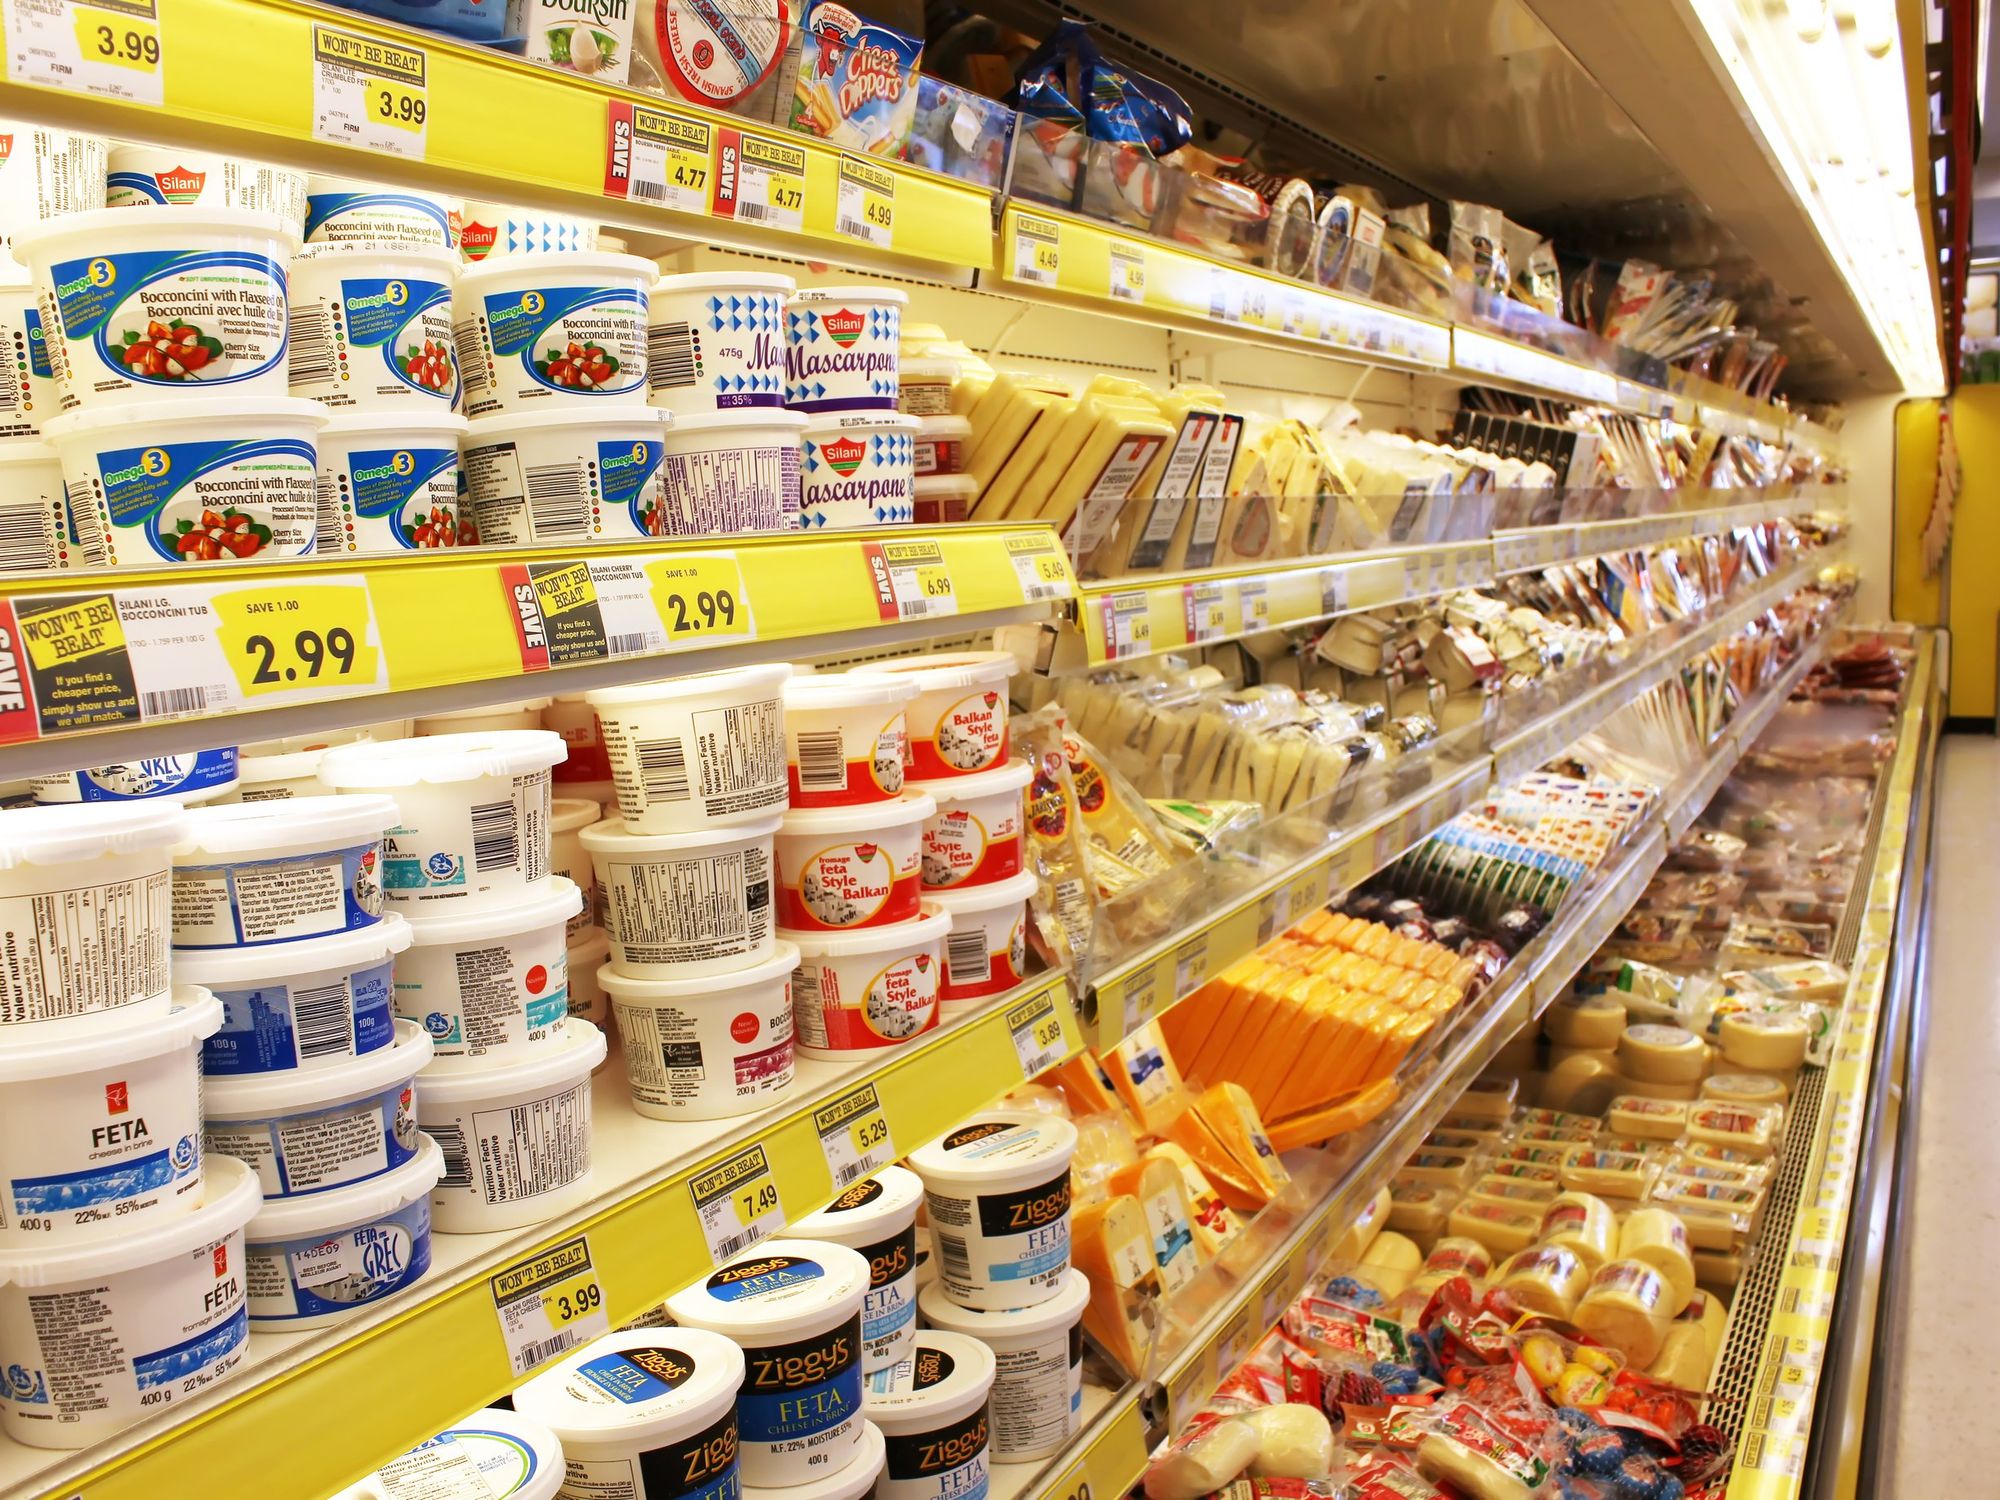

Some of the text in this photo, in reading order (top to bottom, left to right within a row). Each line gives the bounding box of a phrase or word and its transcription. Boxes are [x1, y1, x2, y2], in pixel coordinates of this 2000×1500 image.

[97, 25, 160, 65] 3.99
[322, 33, 362, 58] WON'T
[364, 45, 382, 63] BE
[383, 50, 418, 73] BEAT
[669, 10, 734, 96] SPANISH FRESH CHEESE
[50, 63, 73, 75] FIRM
[321, 62, 342, 75] SILANI
[342, 66, 356, 77] LITE
[321, 70, 372, 88] CRUMBLED FETA
[379, 91, 426, 125] 3.99
[343, 123, 360, 133] FIRM
[639, 114, 705, 142] WON'T BE BEAT
[612, 120, 630, 180] SAVE
[161, 176, 201, 191] Silani
[674, 166, 706, 189] 4.77
[719, 146, 737, 200] SAVE
[775, 188, 802, 209] 4.77
[867, 202, 892, 226] 4.99
[461, 231, 492, 244] Silani
[1040, 249, 1058, 268] 4.49
[57, 261, 110, 299] Omega 3
[140, 289, 209, 304] Bocconcini
[212, 289, 237, 303] with
[239, 290, 275, 307] Flaxseed
[489, 294, 540, 323] Omega 3
[147, 304, 276, 320] Bocconcini avec huile de
[828, 317, 861, 331] Silani
[224, 343, 260, 355] Cherry Size
[225, 352, 266, 362] Format cerise
[719, 347, 743, 359] 475g
[785, 345, 896, 381] Mascarpone
[602, 445, 645, 469] Omega 3
[826, 446, 861, 460] Silani
[104, 451, 164, 487] Omega 3
[590, 564, 633, 574] SILANI CHERRY
[592, 571, 644, 582] BOCCONCINI TUB
[666, 568, 698, 578] SAVE 1.00
[871, 555, 893, 605] SAVE
[1042, 561, 1065, 579] 5.49
[536, 567, 589, 596] WON'T BE
[927, 578, 951, 596] 6.99
[119, 597, 172, 611] SILANI LG.
[246, 600, 300, 614] SAVE 1.00
[552, 586, 582, 610] BEAT
[121, 605, 208, 622] BOCCONCINI TUB
[512, 583, 545, 649] SAVE
[668, 589, 735, 632] 2.99
[22, 603, 114, 643] WON'T BE
[50, 626, 103, 659] BEAT
[244, 627, 356, 685] 2.99
[55, 676, 64, 686] If
[65, 676, 81, 688] you
[84, 672, 103, 683] find
[52, 684, 122, 700] cheaper price,
[42, 697, 136, 717] simply show us and
[953, 710, 993, 726] Balkan
[56, 711, 126, 727] we will match.
[967, 722, 993, 736] Style
[982, 732, 999, 744] feta
[699, 735, 713, 795] Nutrition Facts
[709, 732, 722, 795] Valeur nutritive
[818, 856, 851, 864] fromage
[820, 864, 847, 874] feta
[822, 875, 857, 887] Style
[842, 885, 889, 900] Balkan
[5, 931, 26, 1022] Valeur nutritive
[528, 1031, 541, 1042] 400
[1040, 1020, 1061, 1046] 3.89
[737, 1086, 749, 1096] 200
[91, 1117, 149, 1148] FETA
[859, 1118, 888, 1148] 5.29
[88, 1138, 153, 1161] cheese in brine
[743, 1185, 777, 1217] 7.49
[74, 1200, 140, 1225] 22% 55%
[20, 1218, 42, 1232] 400
[1028, 1219, 1067, 1250] FETA
[303, 1260, 338, 1274] BEST BEFORE
[498, 1245, 582, 1293] WON'T BE BEAT
[718, 1258, 790, 1284] Ziggy's
[204, 1277, 238, 1313] FÉTA
[503, 1294, 541, 1315] SILANI GREEK
[558, 1283, 601, 1320] 3.99
[505, 1303, 541, 1321] FETA CHEESE
[182, 1314, 213, 1334] fromage
[633, 1349, 688, 1381] Ziggy's
[752, 1337, 849, 1388] Ziggy's
[610, 1363, 649, 1389] FETA
[779, 1387, 843, 1422] FETA
[767, 1421, 809, 1435] CHEESE
[811, 1415, 825, 1427] IN
[787, 1429, 841, 1452] 22% MOISTURE
[918, 1417, 988, 1471] Ziggy's
[807, 1455, 822, 1465] 400
[939, 1458, 984, 1494] FETA
